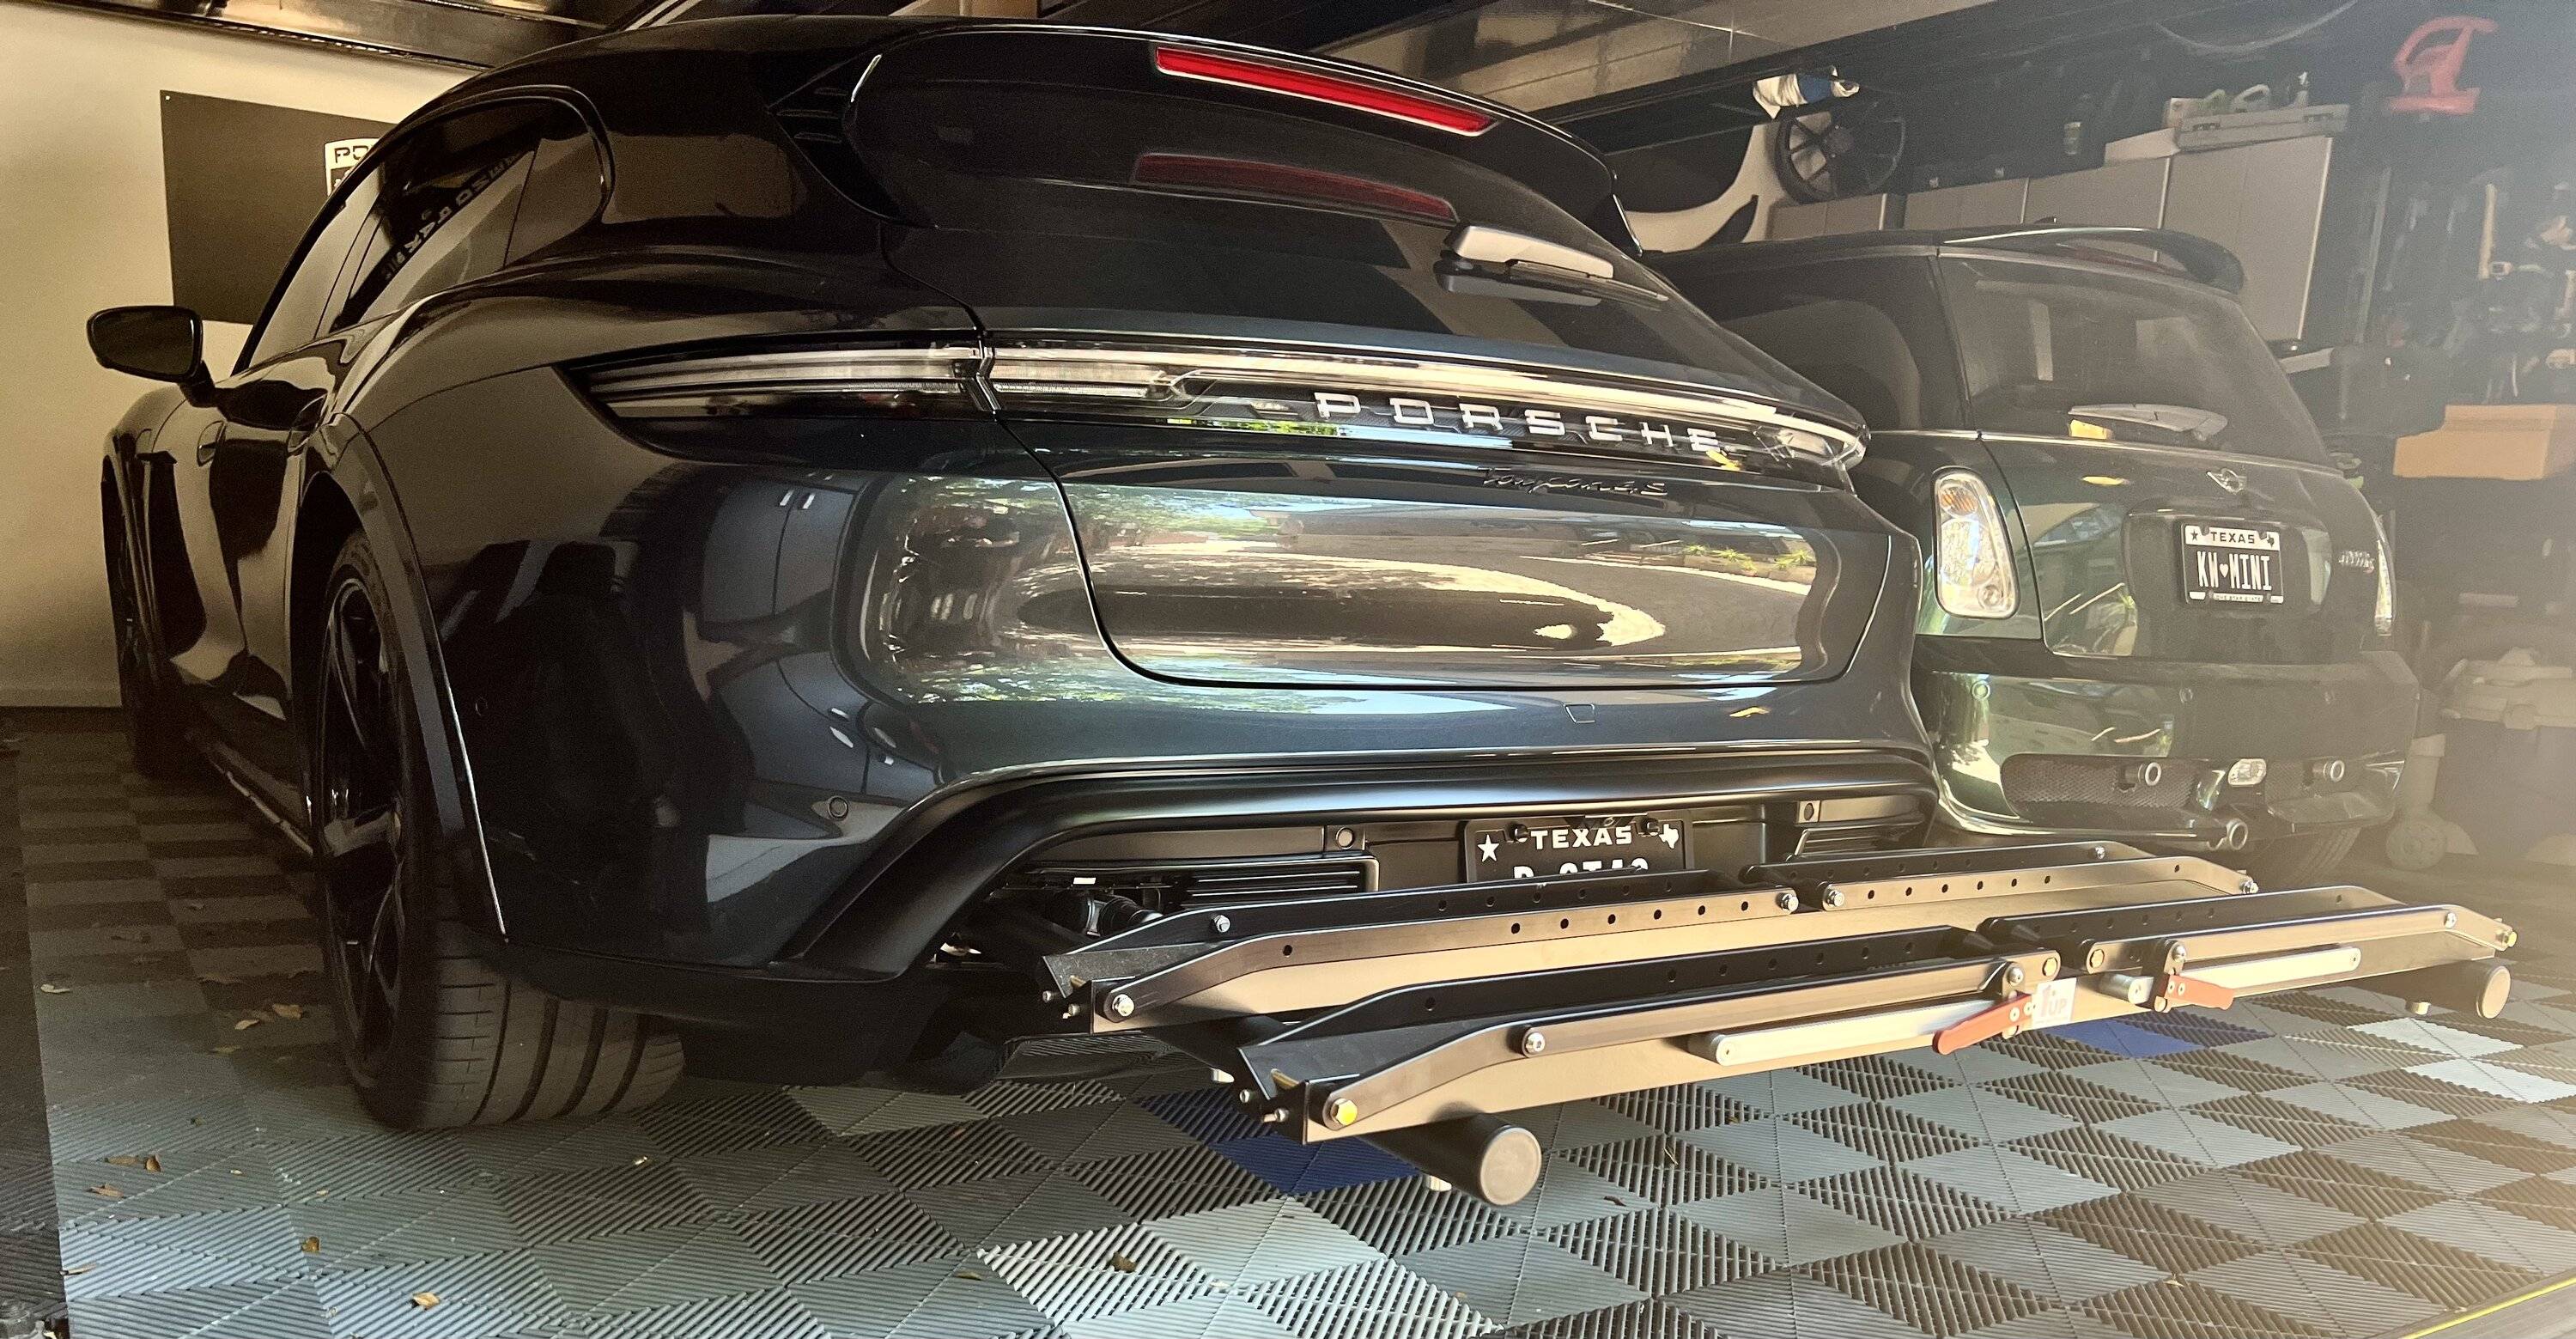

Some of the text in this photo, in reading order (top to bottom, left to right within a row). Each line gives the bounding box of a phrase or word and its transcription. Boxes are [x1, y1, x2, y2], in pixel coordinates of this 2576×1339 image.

[1314, 391, 1724, 453] PORSCHE
[2210, 531, 2256, 545] TEXAS
[1530, 825, 1633, 850] TEXAS
